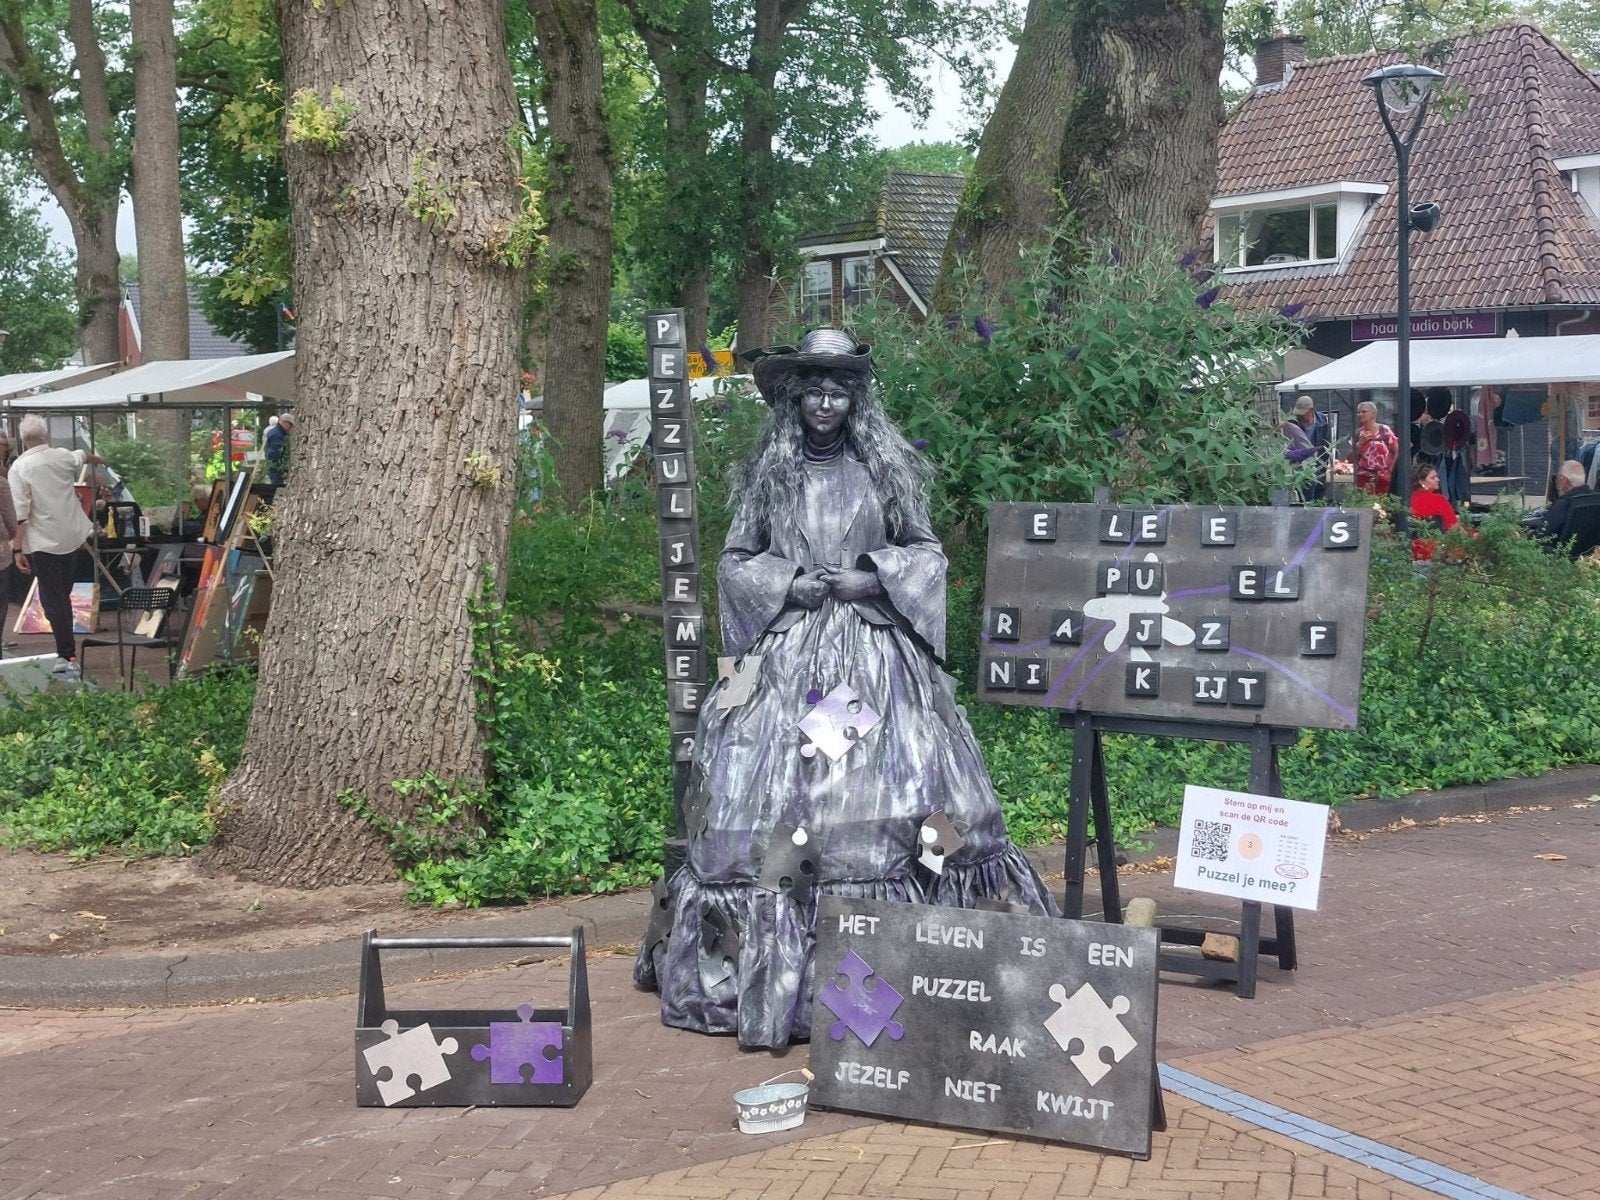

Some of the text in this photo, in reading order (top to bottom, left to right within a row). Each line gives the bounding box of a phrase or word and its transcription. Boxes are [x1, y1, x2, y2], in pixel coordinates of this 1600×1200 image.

[1330, 521, 1350, 545] S
[1310, 626, 1328, 650] F
[1219, 810, 1289, 827] scan de QR code
[1224, 797, 1285, 814] Stem op mij en
[1197, 866, 1297, 893] Puzzel je mee?
[839, 913, 1134, 969] HET LEVEN IS EEN
[911, 974, 992, 1003] PUZZEL
[969, 1030, 1026, 1058] RAAK
[834, 1061, 1114, 1121] JEZELF NIET KWIJT
